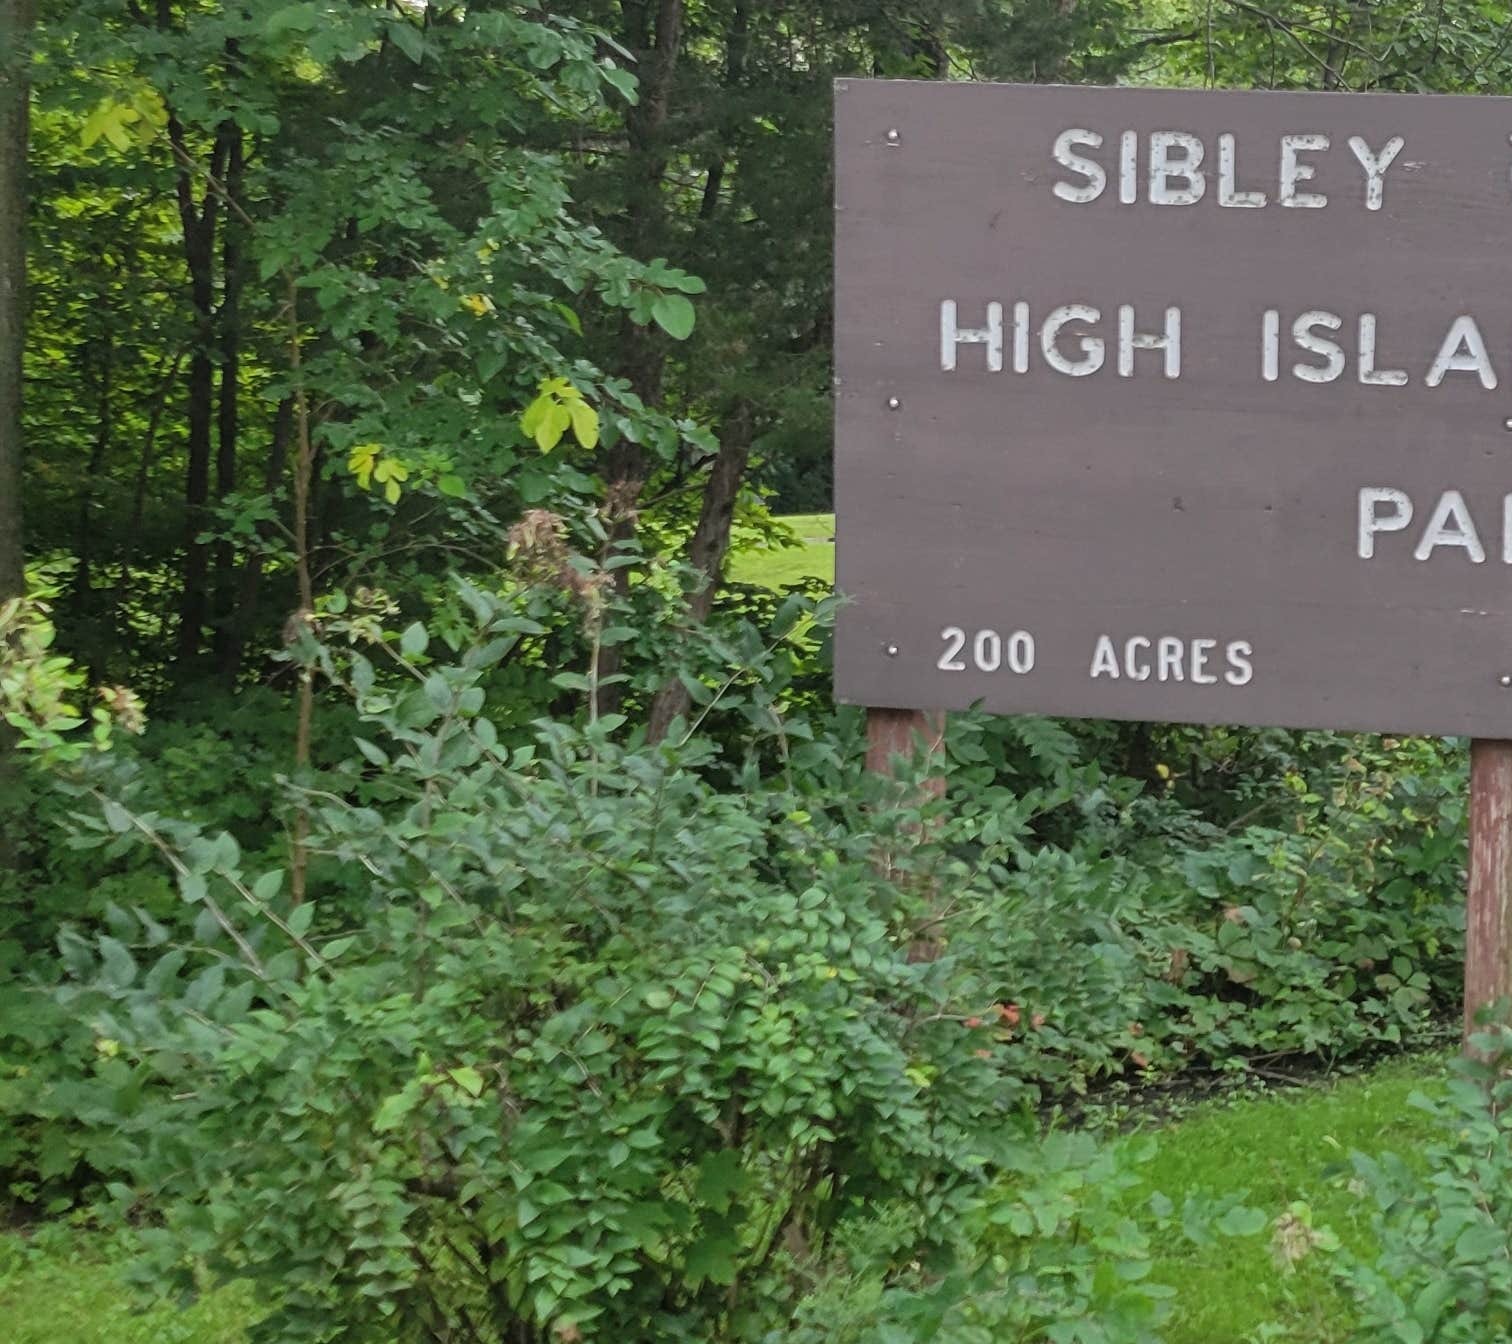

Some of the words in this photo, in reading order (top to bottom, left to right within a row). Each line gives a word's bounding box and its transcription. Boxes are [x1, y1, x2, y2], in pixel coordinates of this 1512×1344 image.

[1052, 129, 1404, 210] SIBLEY
[940, 299, 1181, 380] HIGH
[936, 626, 1036, 674] 200
[1090, 635, 1254, 687] ACRES
